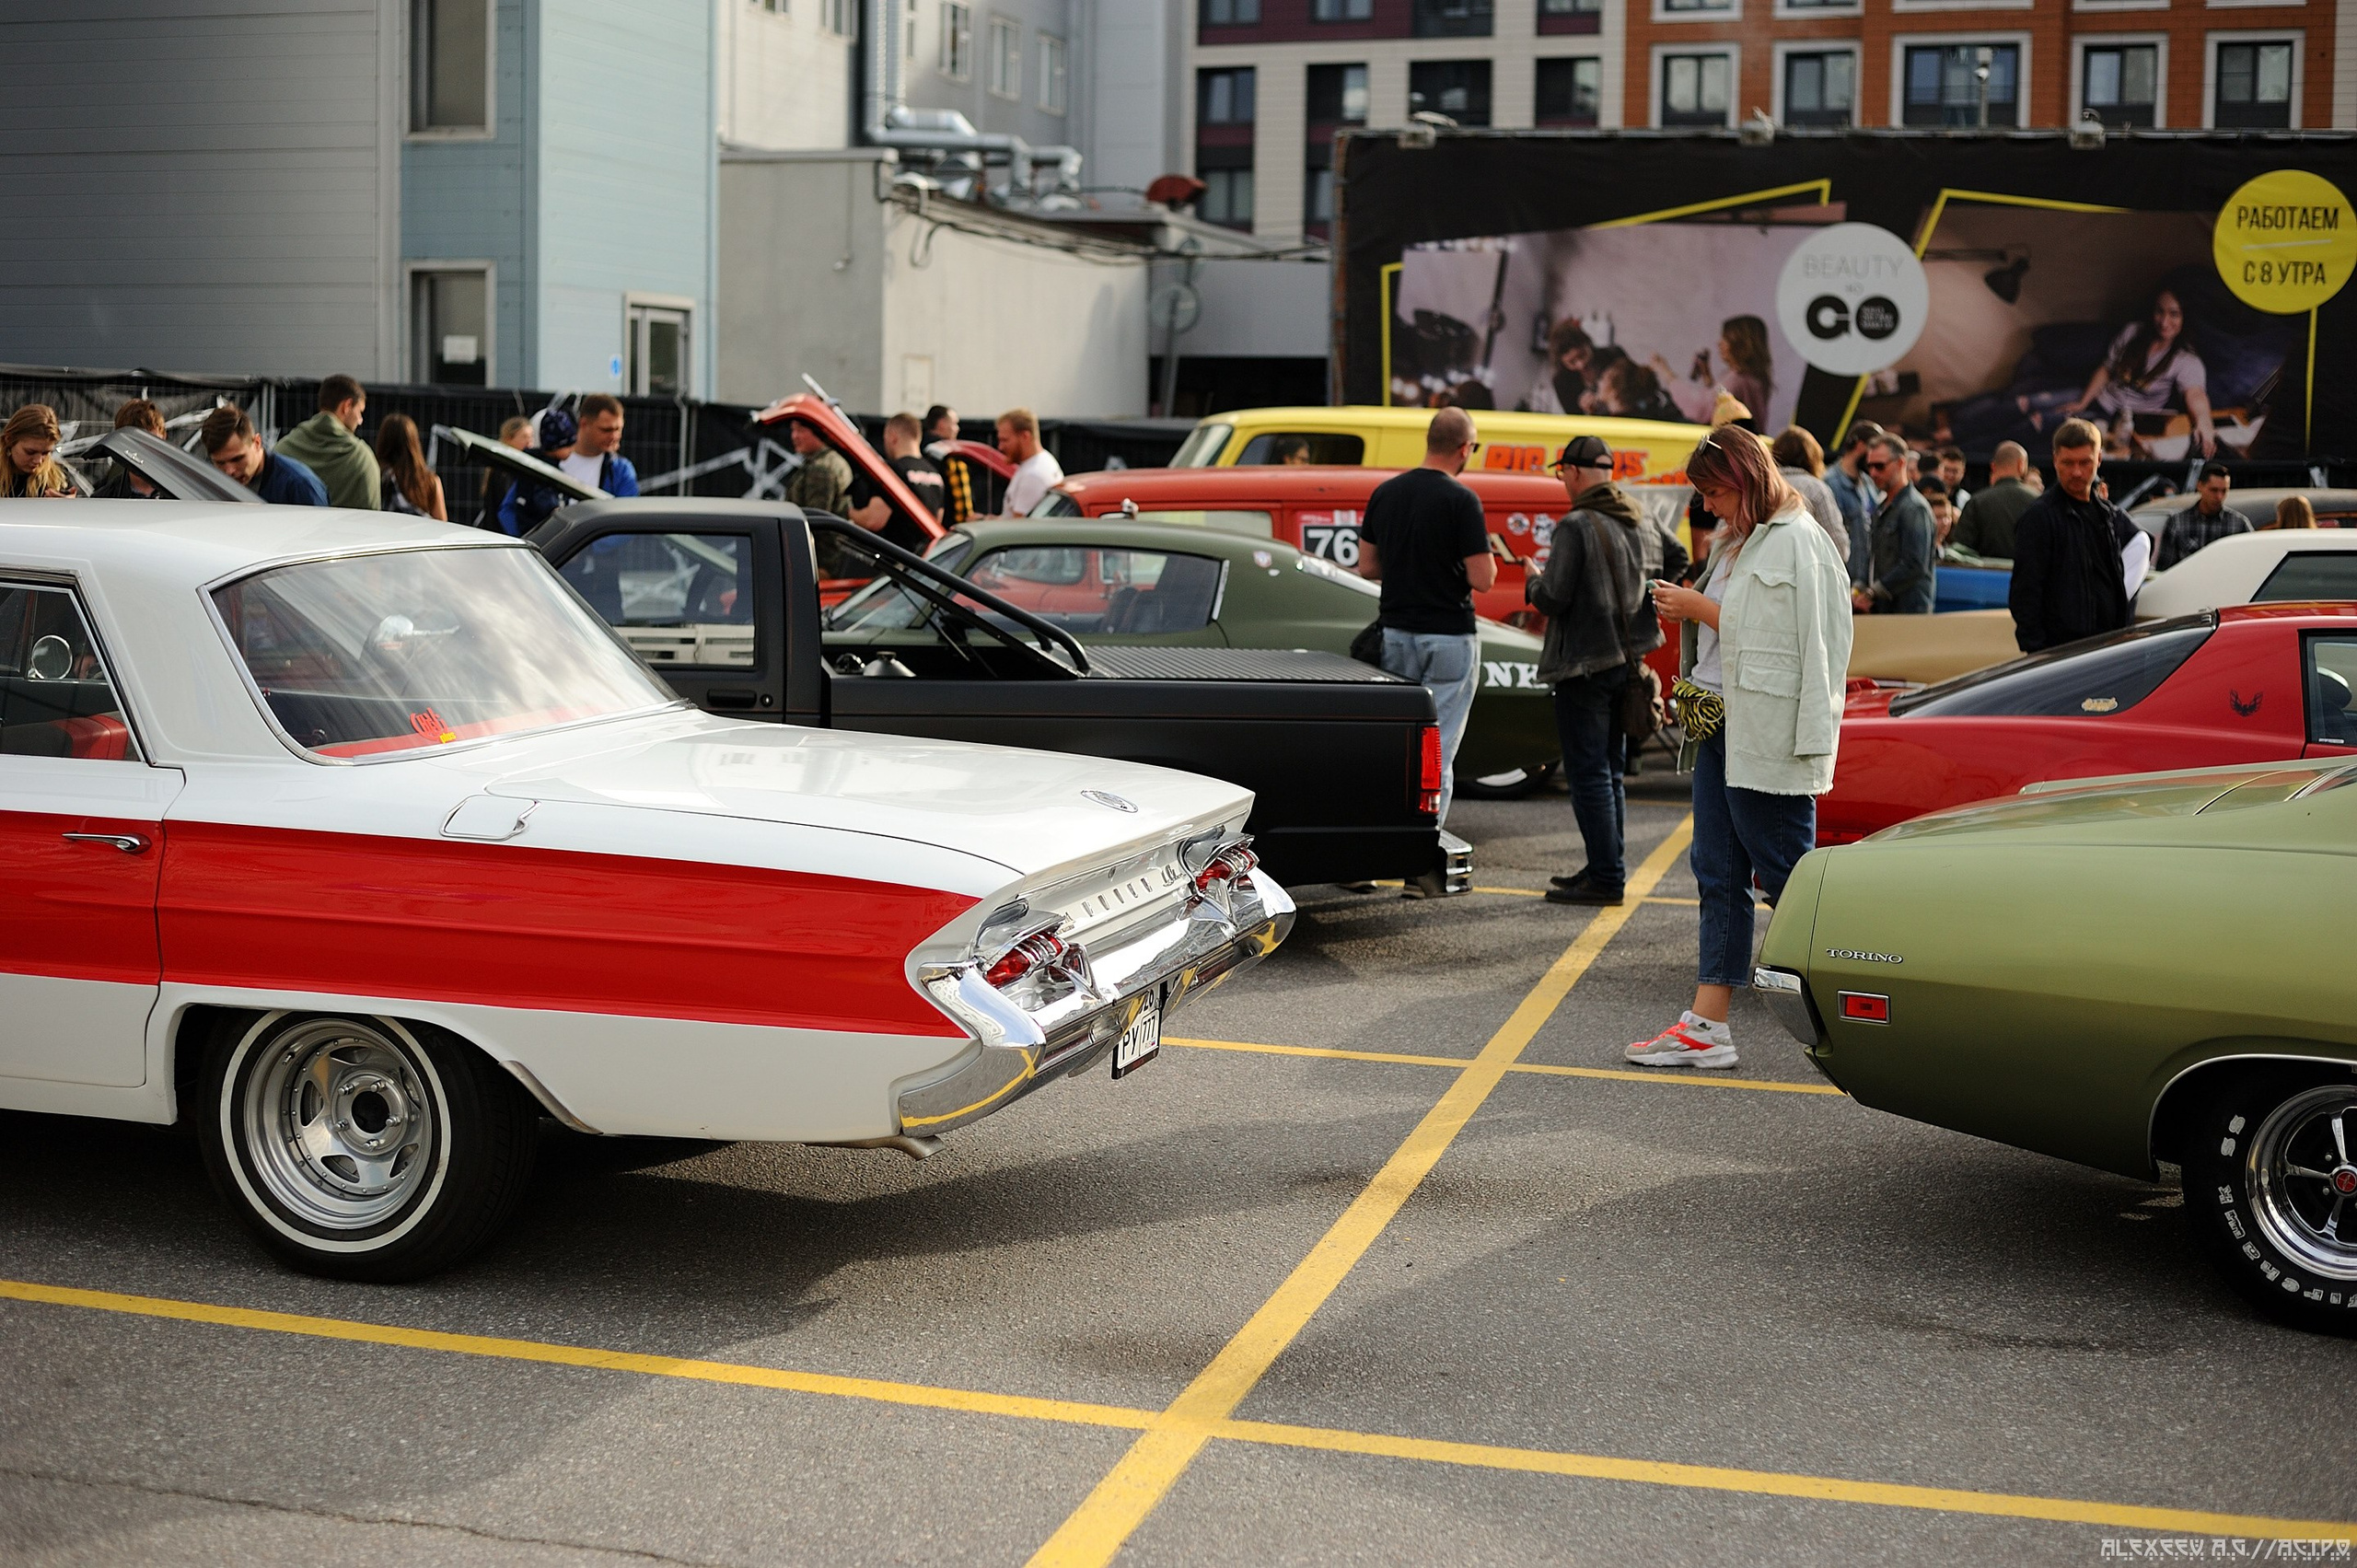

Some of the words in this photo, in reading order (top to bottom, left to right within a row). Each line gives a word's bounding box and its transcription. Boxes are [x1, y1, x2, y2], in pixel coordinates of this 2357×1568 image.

[2236, 205, 2340, 230] РАБОТАЕМ
[1802, 253, 1905, 280] BEAUTY
[2243, 261, 2256, 285] С
[2259, 261, 2273, 285] 8
[2278, 261, 2326, 285] УТРА
[1306, 528, 1360, 567] 76
[1826, 948, 1904, 964] TORINO
[1142, 1015, 1156, 1044] 777
